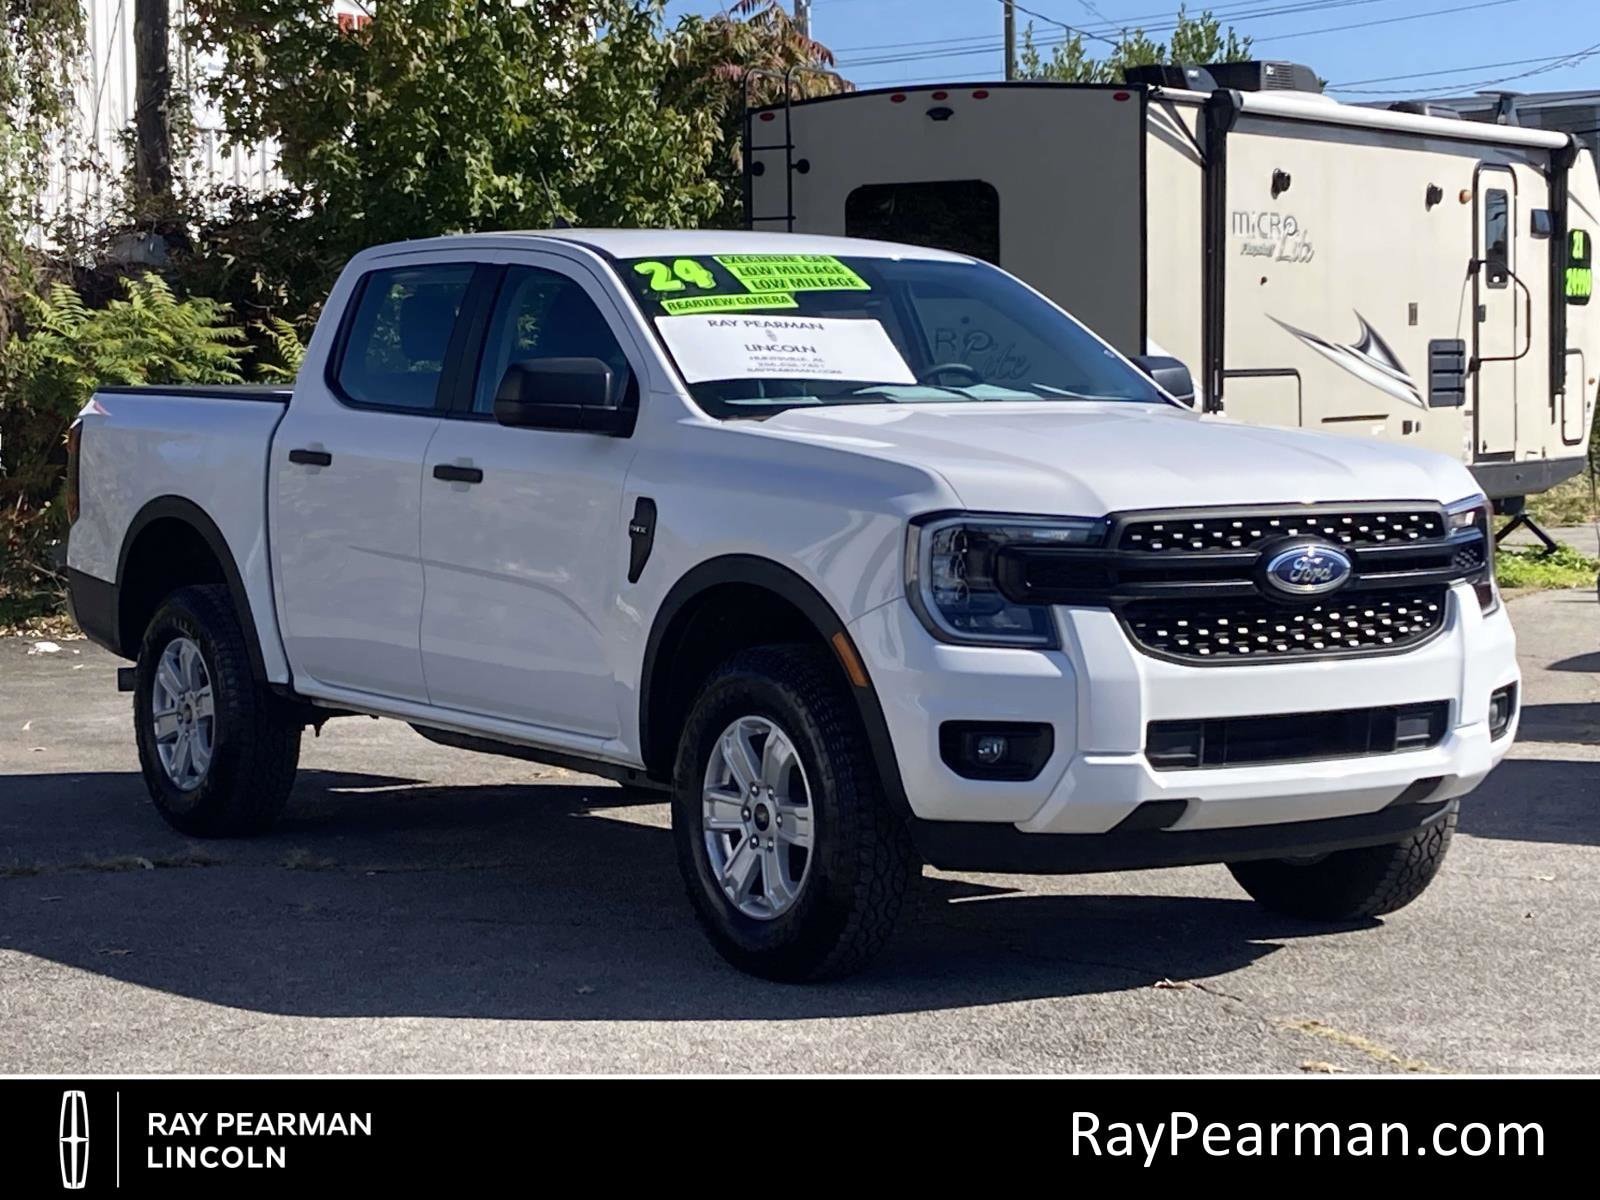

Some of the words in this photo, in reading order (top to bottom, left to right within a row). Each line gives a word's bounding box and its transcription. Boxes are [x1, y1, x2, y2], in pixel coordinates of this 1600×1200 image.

[634, 259, 716, 292] 24
[736, 266, 773, 276] LOW
[775, 265, 845, 275] MILEAGE
[751, 278, 787, 290] LOW
[788, 277, 859, 289] MILEAGE
[666, 297, 734, 311] REARVIEW
[735, 294, 791, 305] CAMERA
[707, 319, 738, 327] RAY
[743, 320, 824, 330] PEARMAN
[744, 344, 817, 353] LINCOLN
[1289, 556, 1334, 583] Ford
